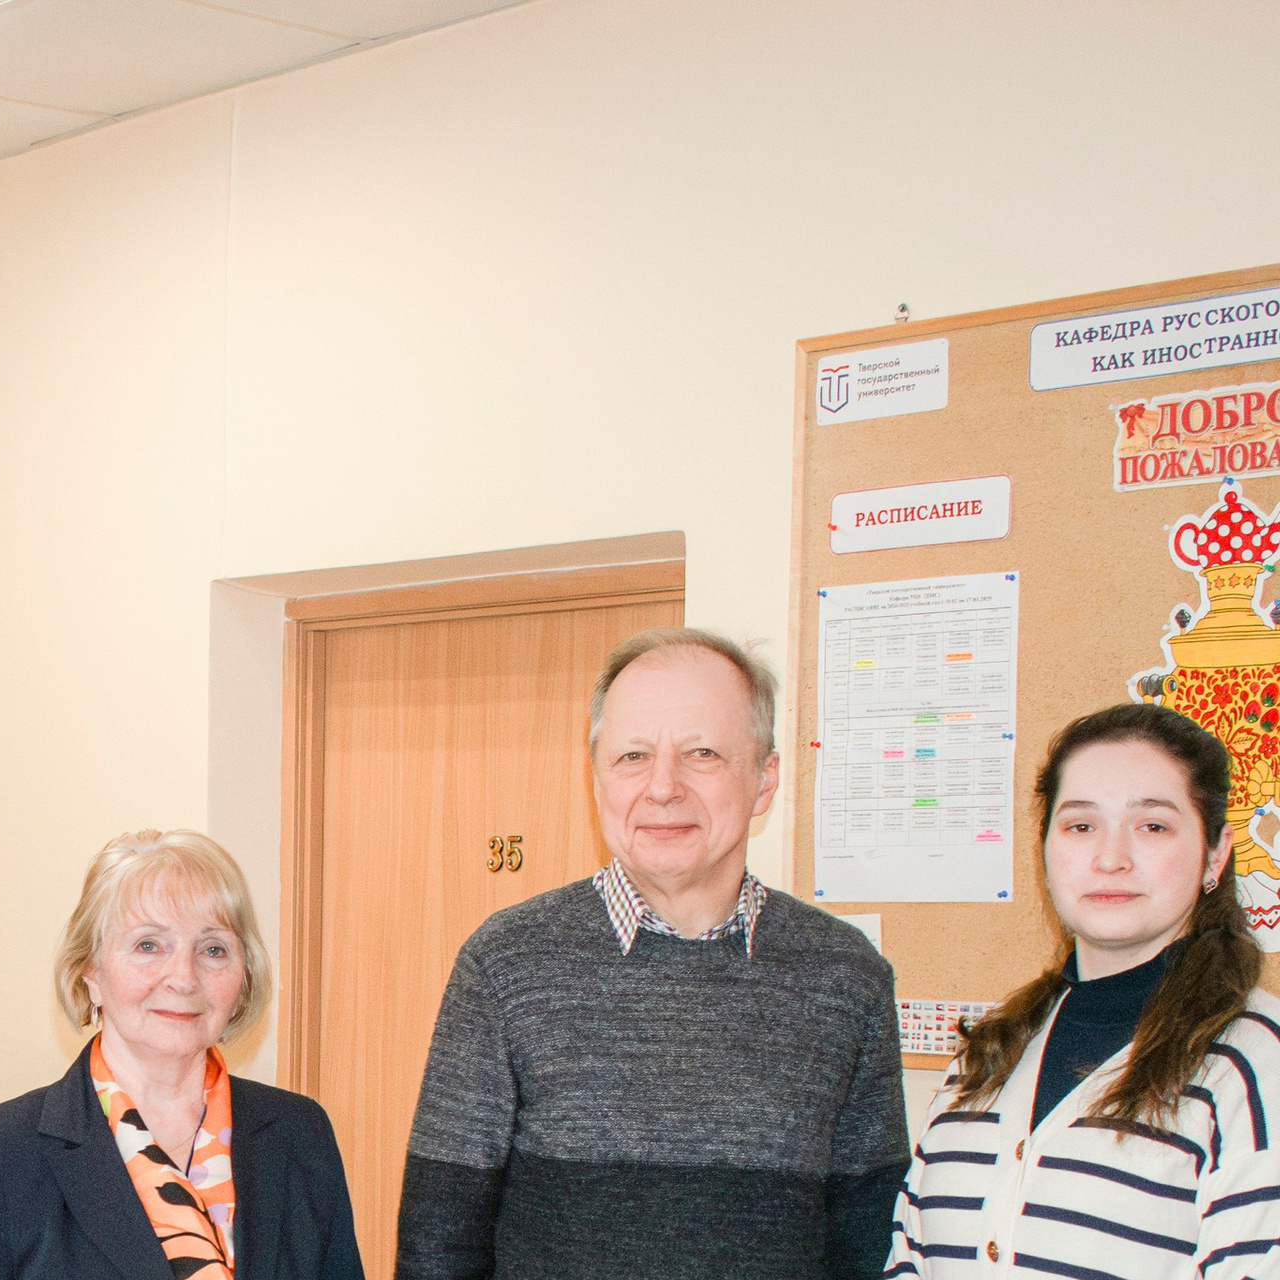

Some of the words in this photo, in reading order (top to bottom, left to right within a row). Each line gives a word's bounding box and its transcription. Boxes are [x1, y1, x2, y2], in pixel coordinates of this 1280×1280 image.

[1054, 317, 1155, 348] КАФЕДРА
[1091, 351, 1135, 373] КАК
[1141, 328, 1280, 366] ИНОСТРАНН
[856, 365, 940, 387] государственный
[857, 358, 900, 373] Тверской
[856, 383, 916, 401] университет
[854, 499, 983, 528] РАСПИСАНИЕ
[486, 835, 523, 873] 35
